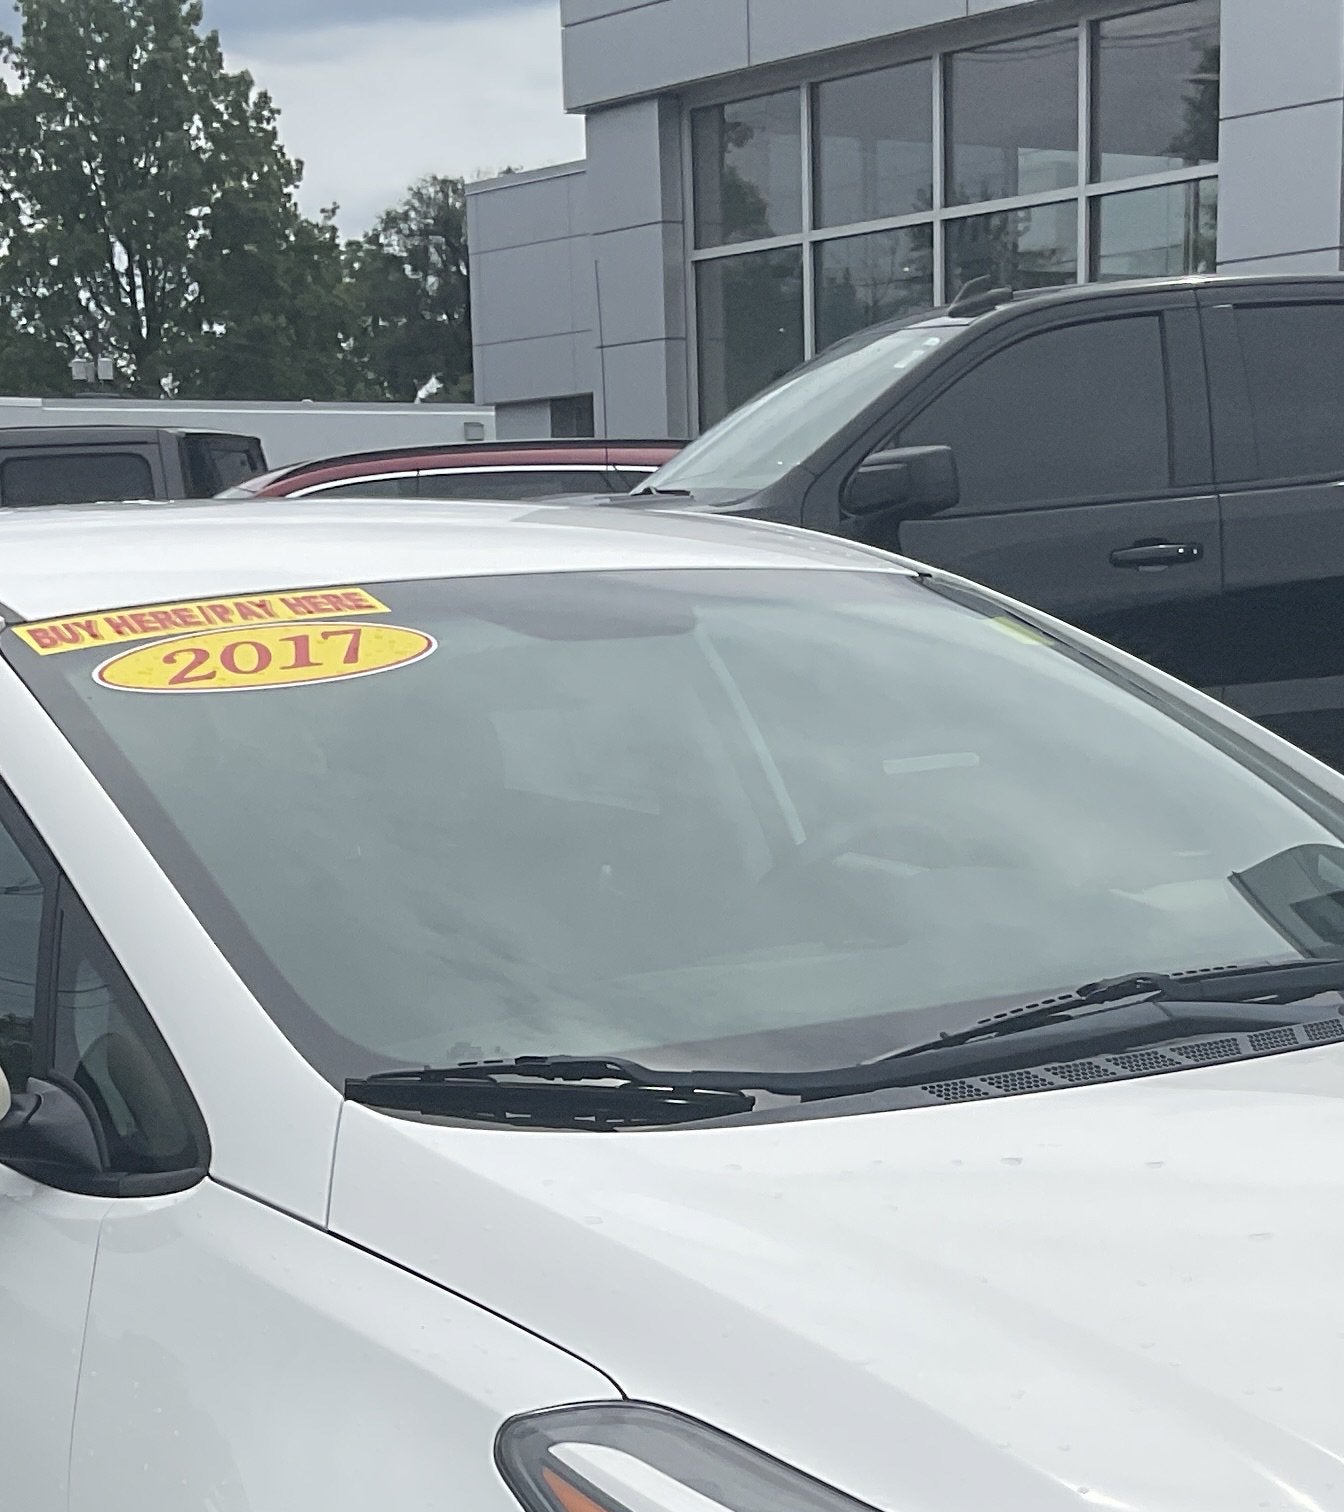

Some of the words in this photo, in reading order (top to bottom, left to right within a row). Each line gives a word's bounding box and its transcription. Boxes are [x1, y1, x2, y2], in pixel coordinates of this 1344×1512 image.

[27, 619, 102, 649] BUY
[278, 592, 376, 616] HERE
[162, 628, 362, 686] 2017
